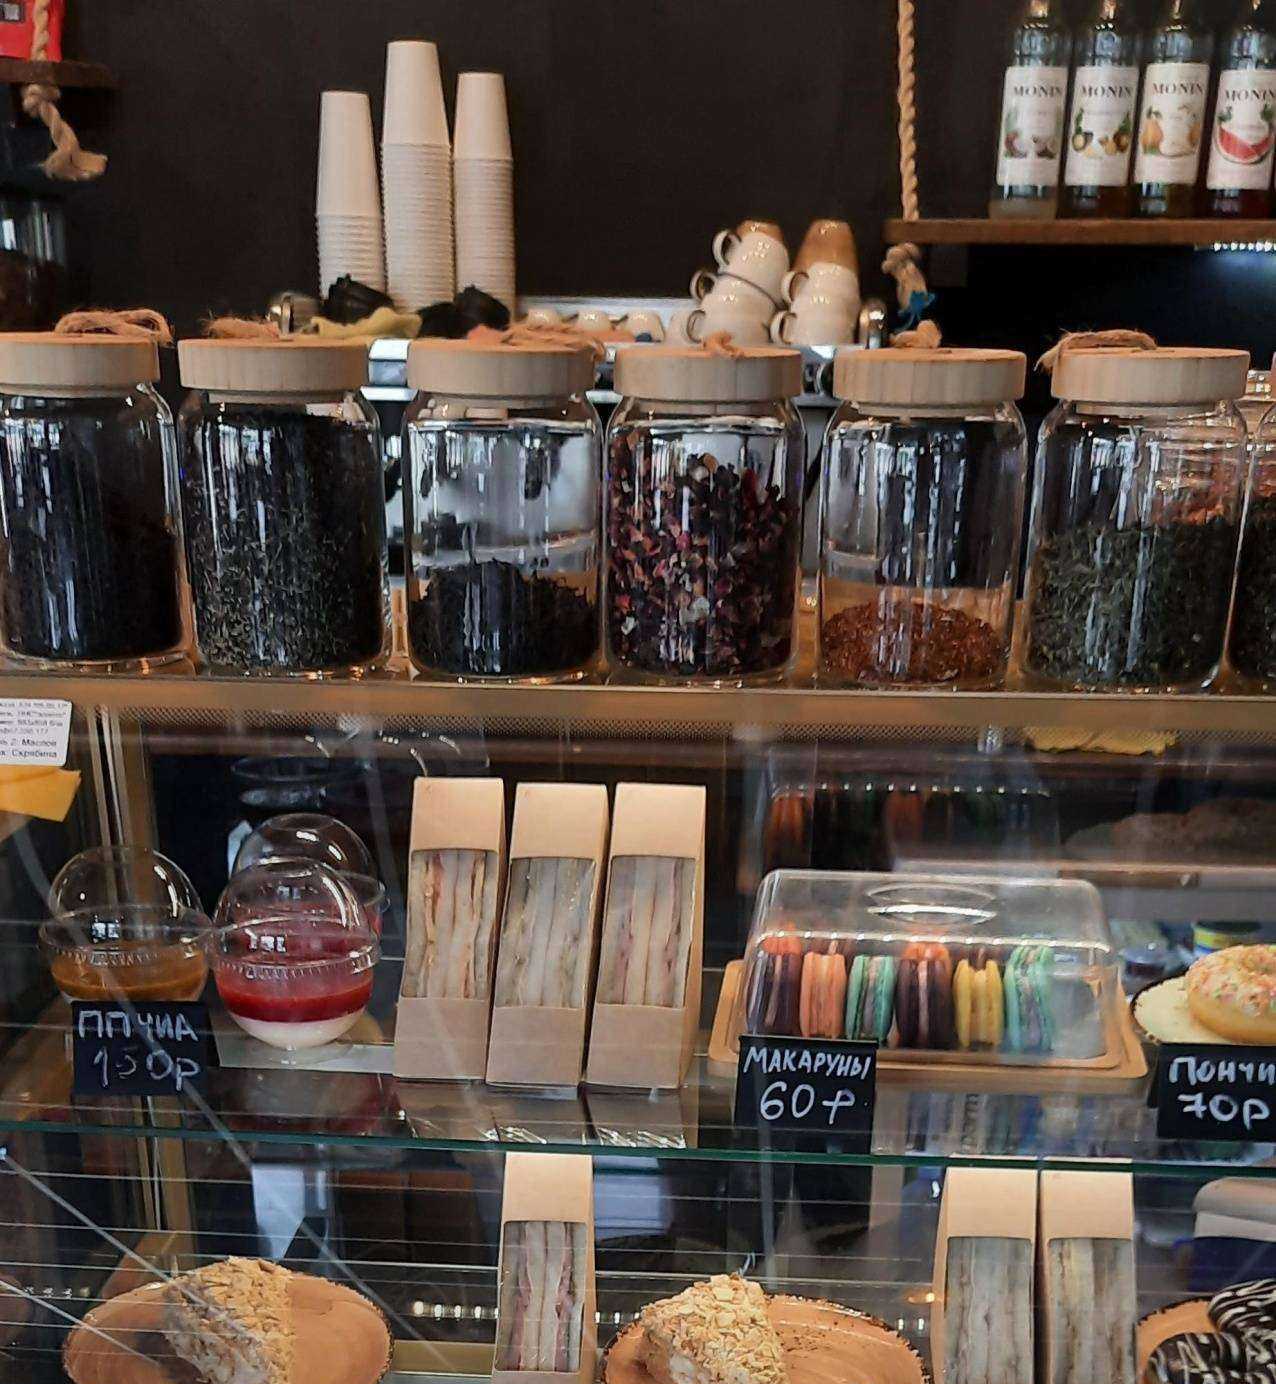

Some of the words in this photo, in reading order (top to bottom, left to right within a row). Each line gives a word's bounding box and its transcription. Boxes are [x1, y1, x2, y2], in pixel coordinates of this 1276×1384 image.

[1013, 84, 1062, 98] MONIN
[1081, 84, 1132, 98] MONIN
[1151, 81, 1204, 96] MONIN
[742, 1045, 872, 1080] МАКАРУНЫ
